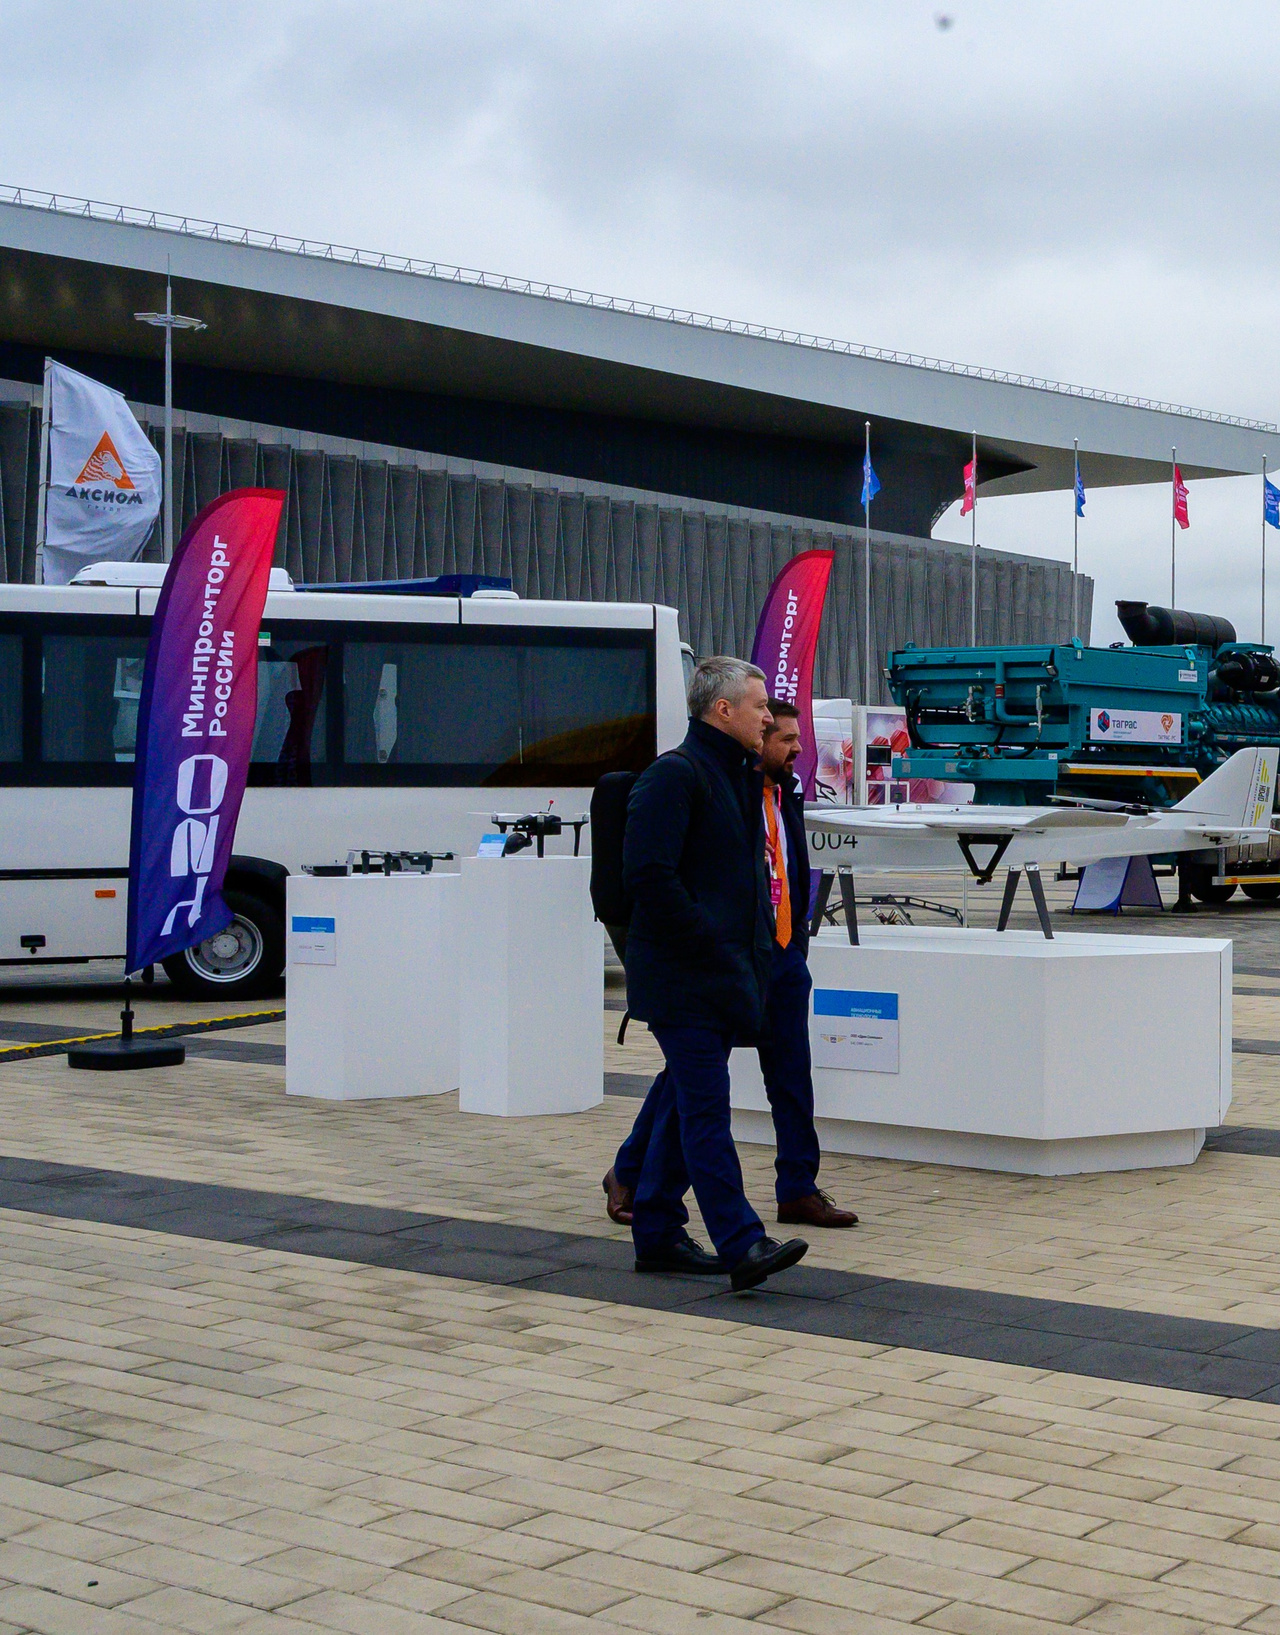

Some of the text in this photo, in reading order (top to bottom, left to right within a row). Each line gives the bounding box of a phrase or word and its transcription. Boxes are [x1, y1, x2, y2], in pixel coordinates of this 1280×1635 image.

[65, 486, 143, 505] АКСИОМ
[181, 534, 229, 737] Минпромторг
[209, 630, 235, 738] России
[774, 589, 798, 701] промторг
[811, 831, 858, 851] 004
